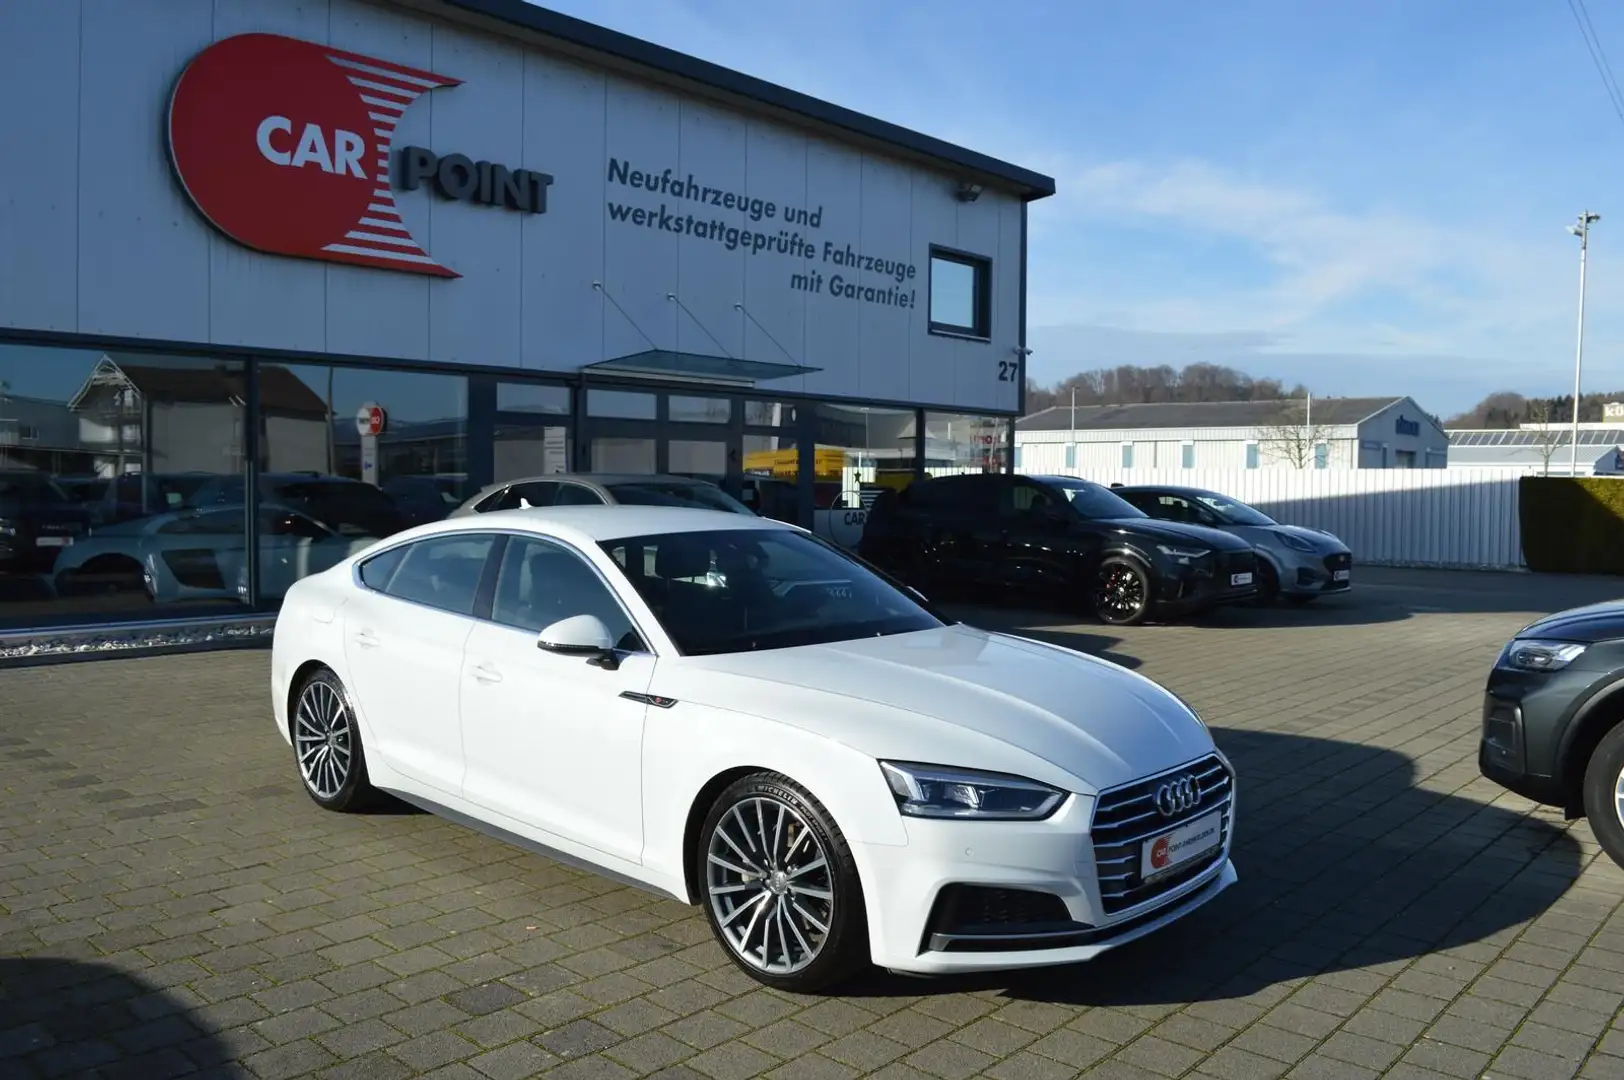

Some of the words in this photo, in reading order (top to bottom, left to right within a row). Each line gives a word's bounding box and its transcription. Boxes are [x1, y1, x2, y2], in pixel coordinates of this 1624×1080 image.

[256, 115, 368, 179] CAR
[402, 145, 554, 214] POINT
[608, 159, 776, 221] Neufahrzeuge
[783, 205, 822, 228] und
[608, 201, 816, 260] werkstattgeprüfte
[822, 241, 917, 281] Fahrzeuge
[791, 271, 823, 293] mit
[828, 279, 916, 309] Garantie!
[998, 361, 1018, 382] 27
[845, 511, 865, 526] CAR
[757, 785, 798, 804] MICHELIN
